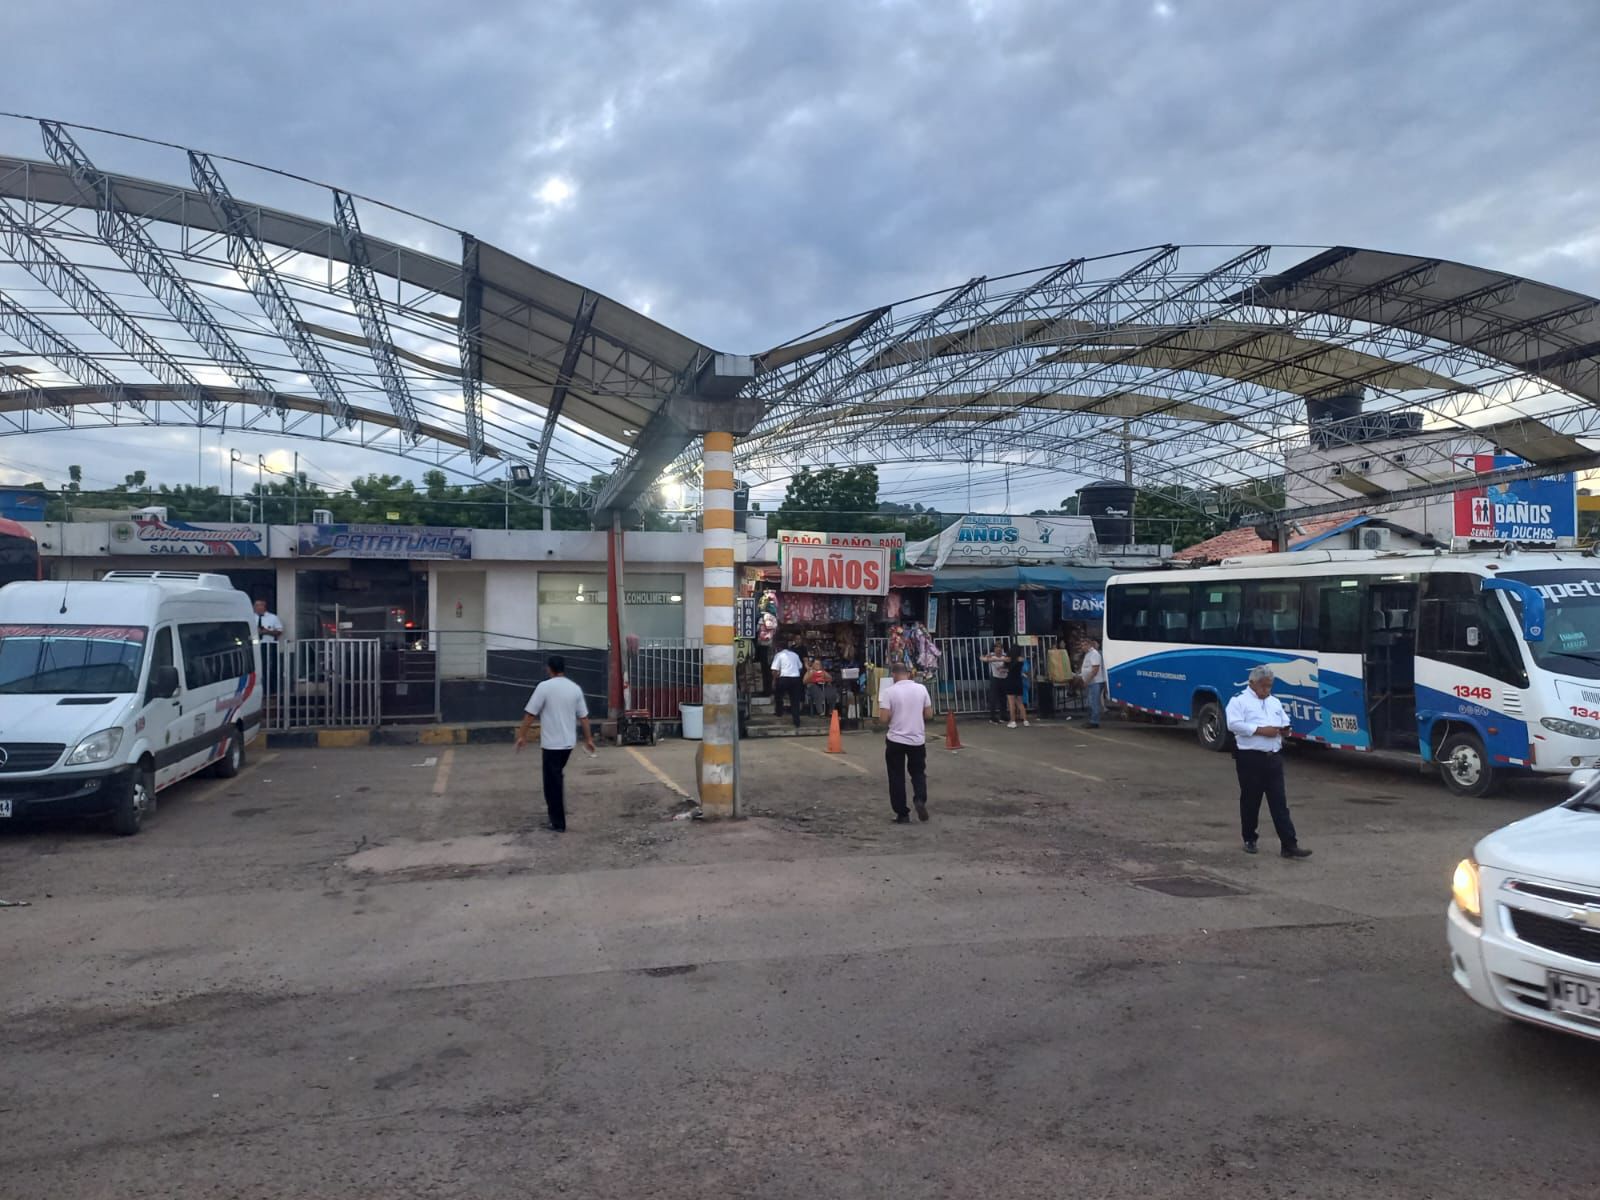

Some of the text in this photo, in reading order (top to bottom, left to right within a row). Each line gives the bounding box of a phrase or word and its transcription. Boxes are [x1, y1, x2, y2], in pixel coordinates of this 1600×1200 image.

[1494, 501, 1551, 524] BAÑOS
[150, 544, 190, 554] SALA
[879, 536, 903, 548] BAÑO
[791, 553, 880, 591] BAÑOS
[1453, 685, 1492, 699] 1346
